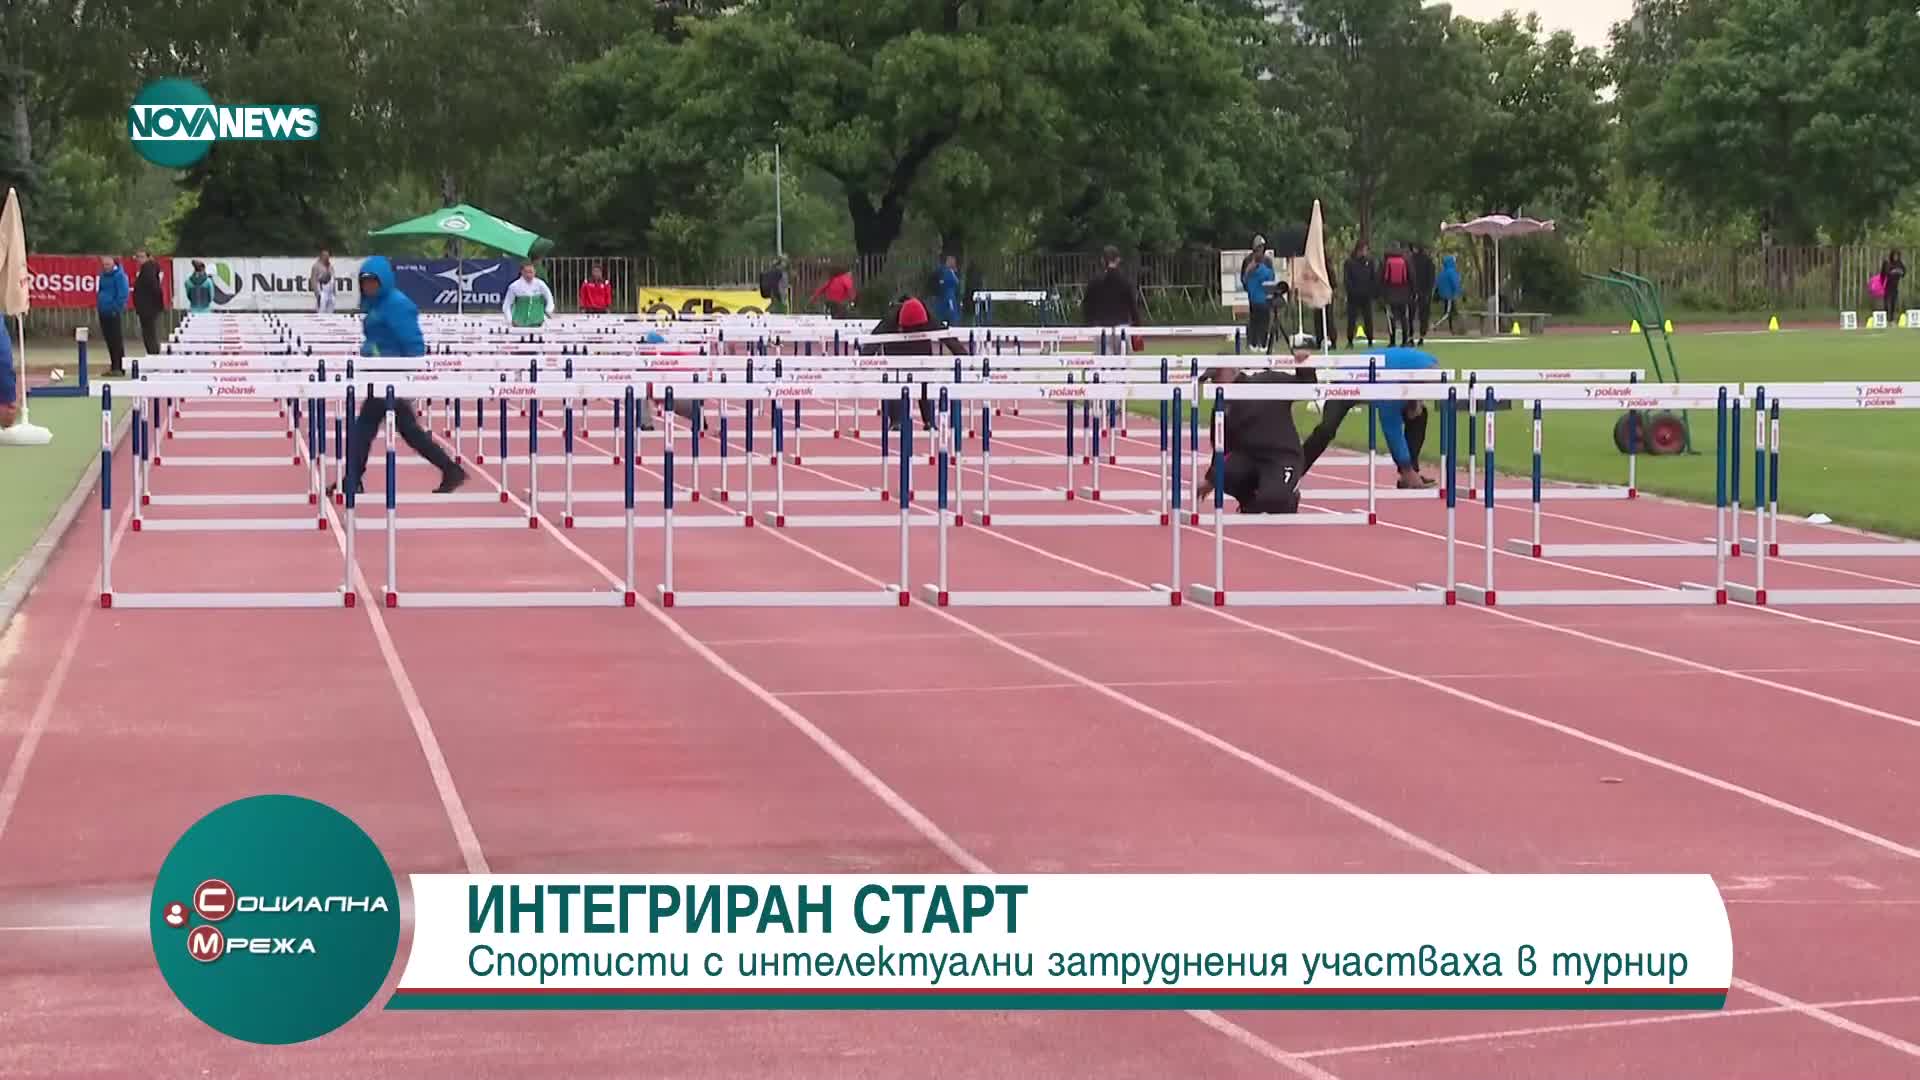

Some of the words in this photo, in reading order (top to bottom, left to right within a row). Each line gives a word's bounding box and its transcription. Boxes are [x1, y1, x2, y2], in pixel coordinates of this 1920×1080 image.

[217, 385, 256, 396] polanik
[499, 386, 536, 396] polanik
[775, 387, 813, 397] polanik
[1048, 387, 1086, 397] polanik
[1324, 387, 1360, 398] polanik
[1595, 386, 1632, 397] polanik
[1865, 385, 1903, 397] polanik
[1627, 398, 1658, 408] polanik
